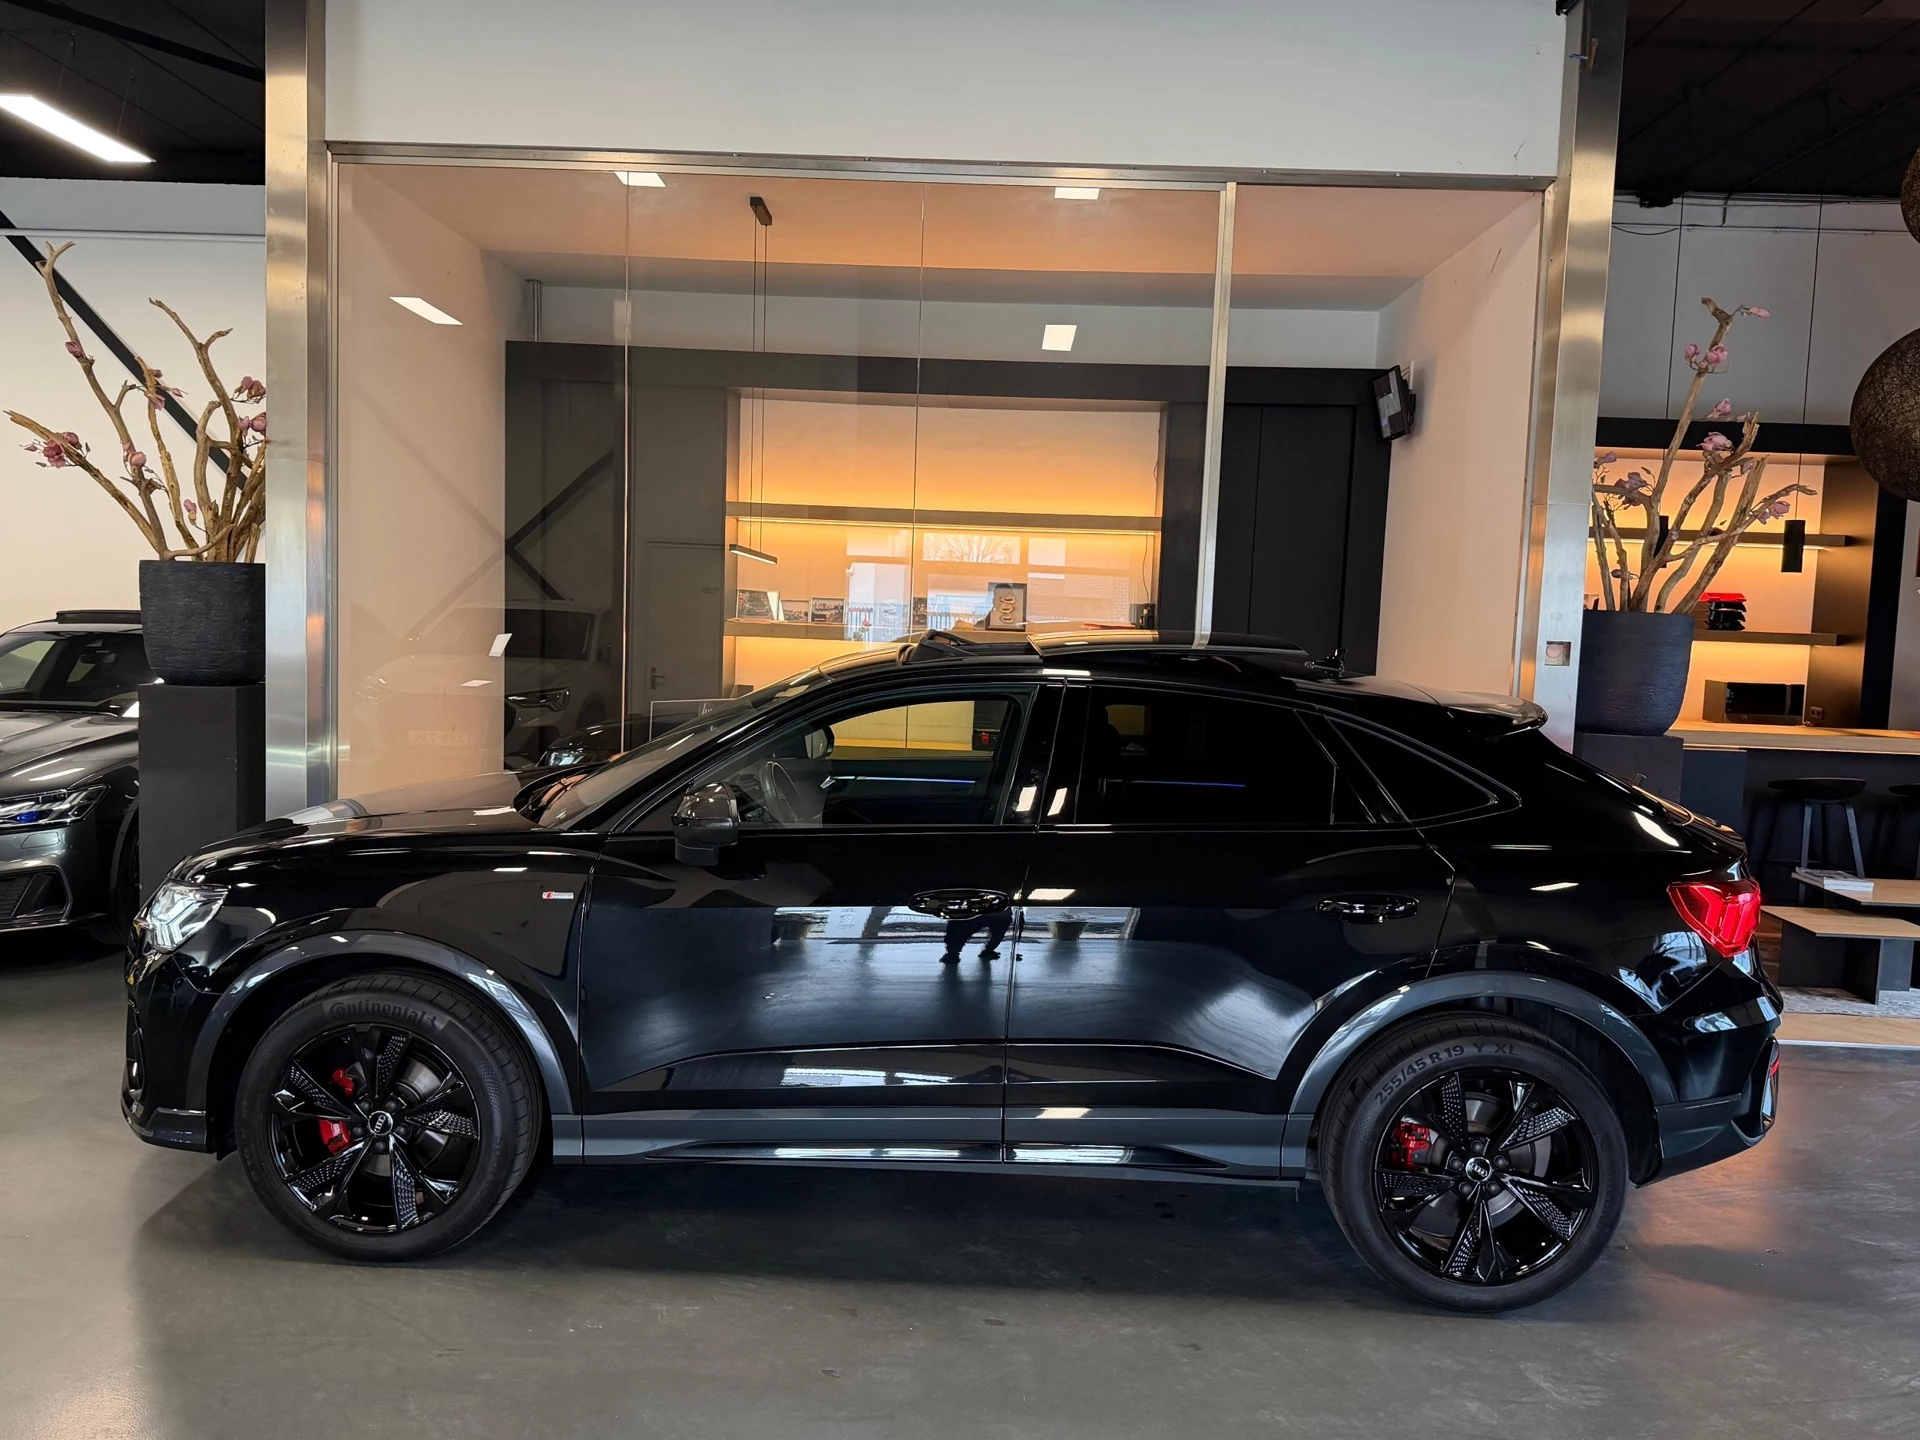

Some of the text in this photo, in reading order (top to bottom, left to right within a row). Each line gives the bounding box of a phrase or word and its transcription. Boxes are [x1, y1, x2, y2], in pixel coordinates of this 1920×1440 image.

[329, 1000, 426, 1025] Continental
[1375, 1058, 1427, 1105] 255/45
[1472, 1043, 1484, 1053] Y
[1494, 1043, 1518, 1056] XL
